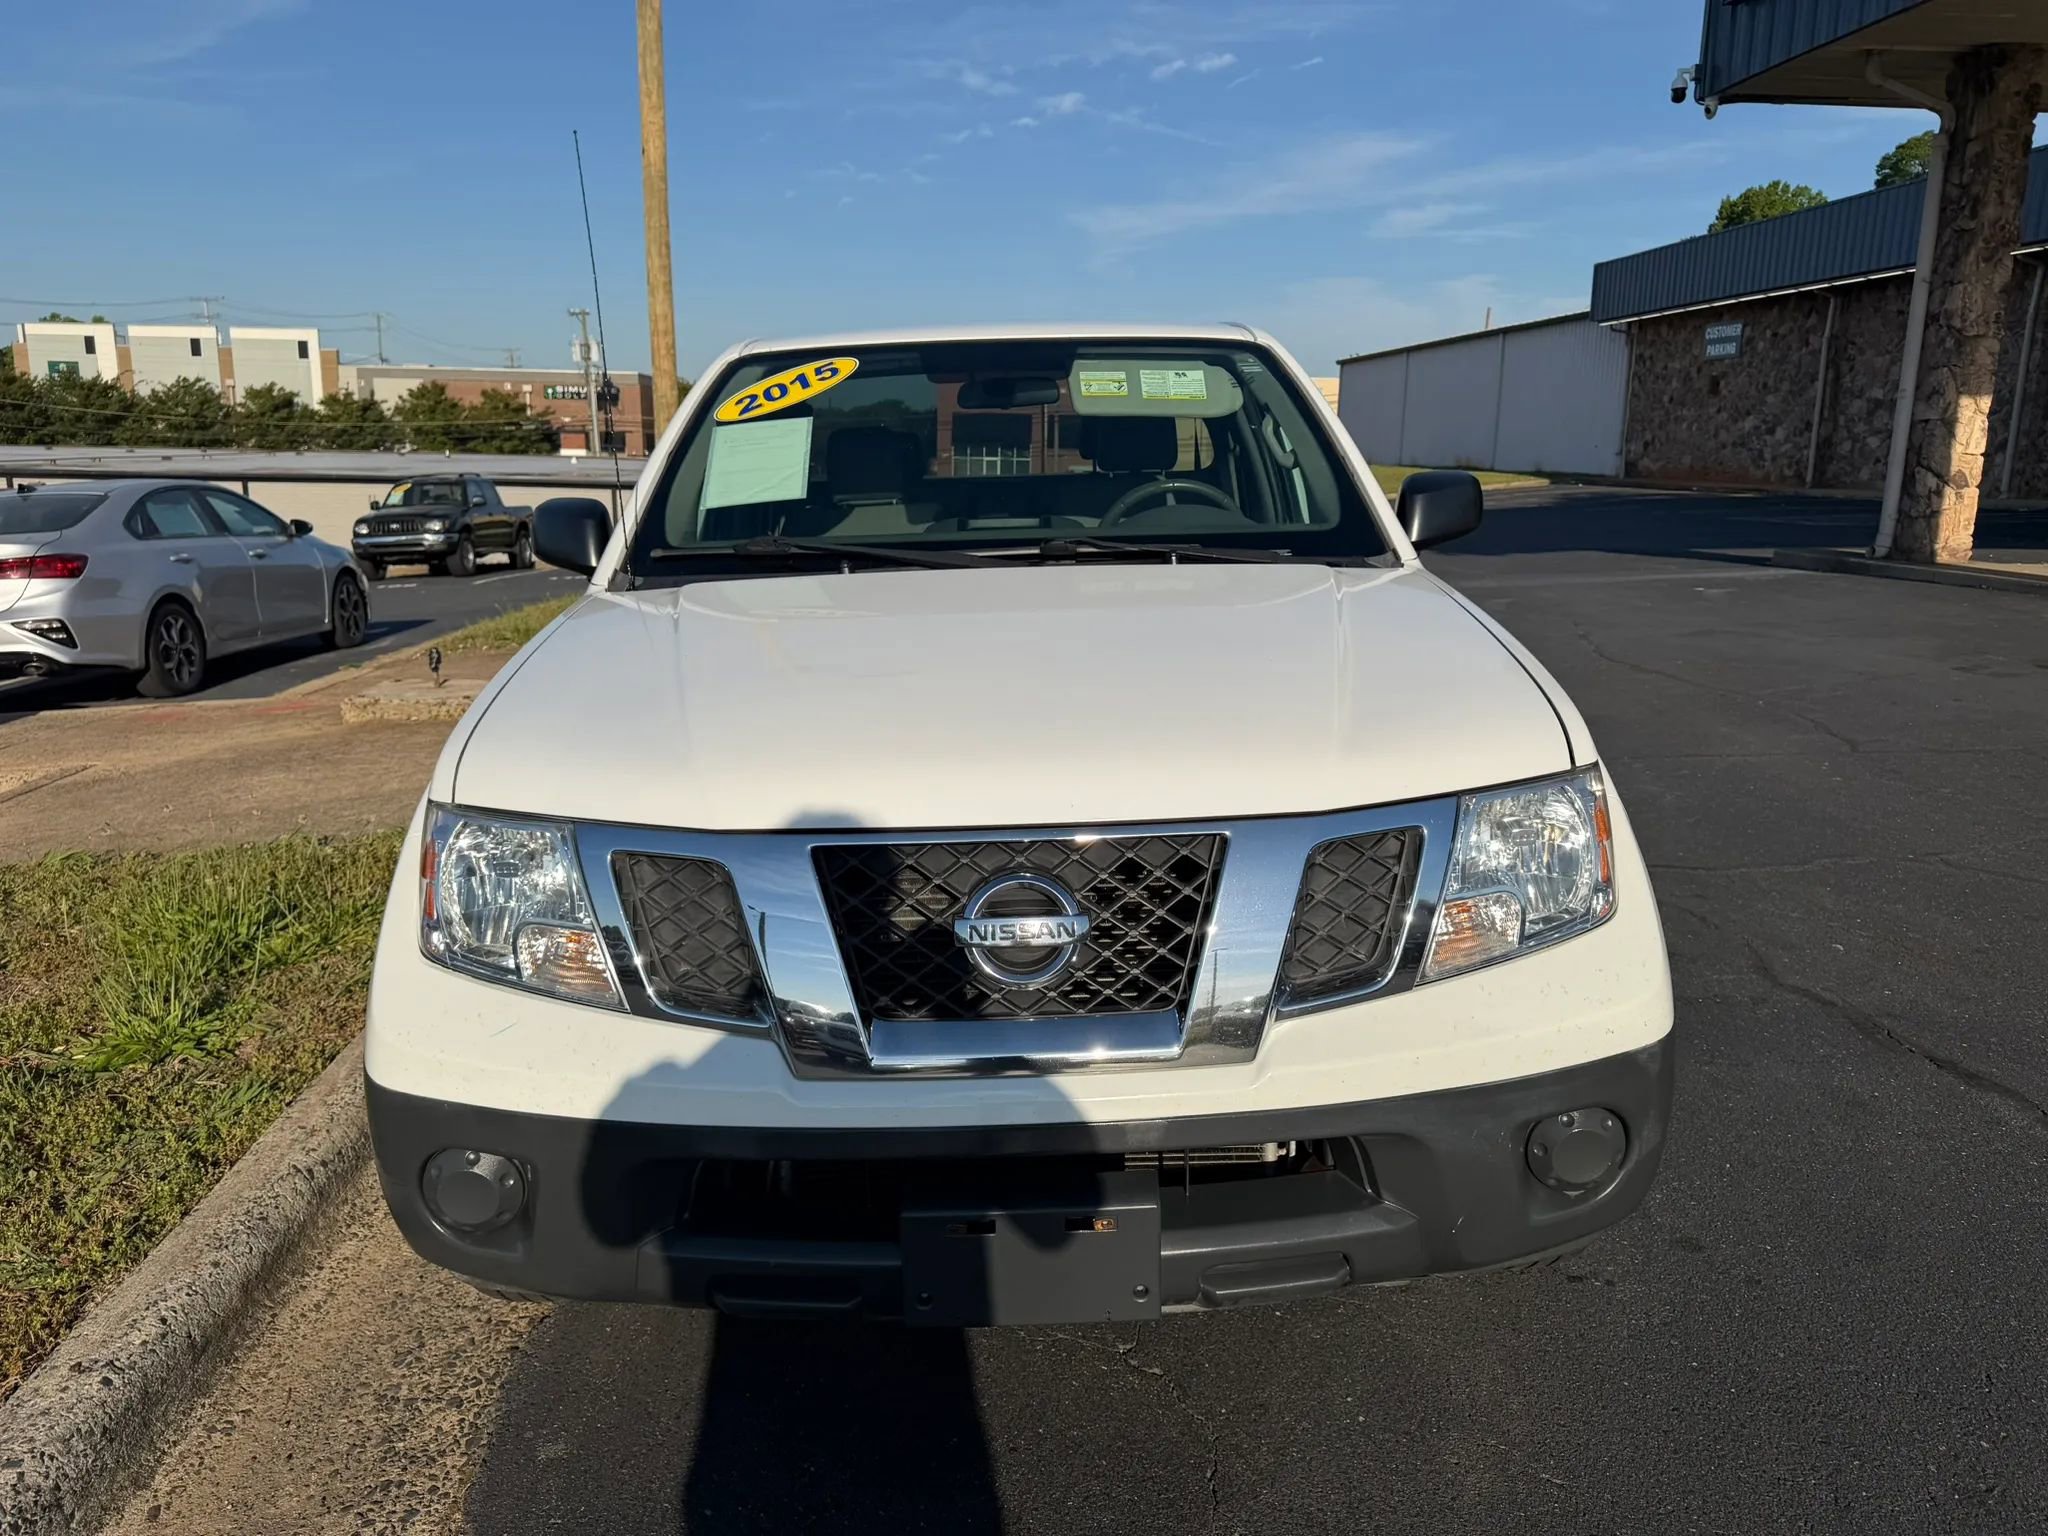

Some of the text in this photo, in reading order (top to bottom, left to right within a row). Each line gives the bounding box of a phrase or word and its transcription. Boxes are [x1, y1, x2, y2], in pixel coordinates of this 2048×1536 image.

[1705, 323, 1742, 339] CUSTOMER
[1706, 342, 1737, 357] PARKING
[734, 361, 841, 416] 2015
[968, 920, 1077, 942] NISSAN
